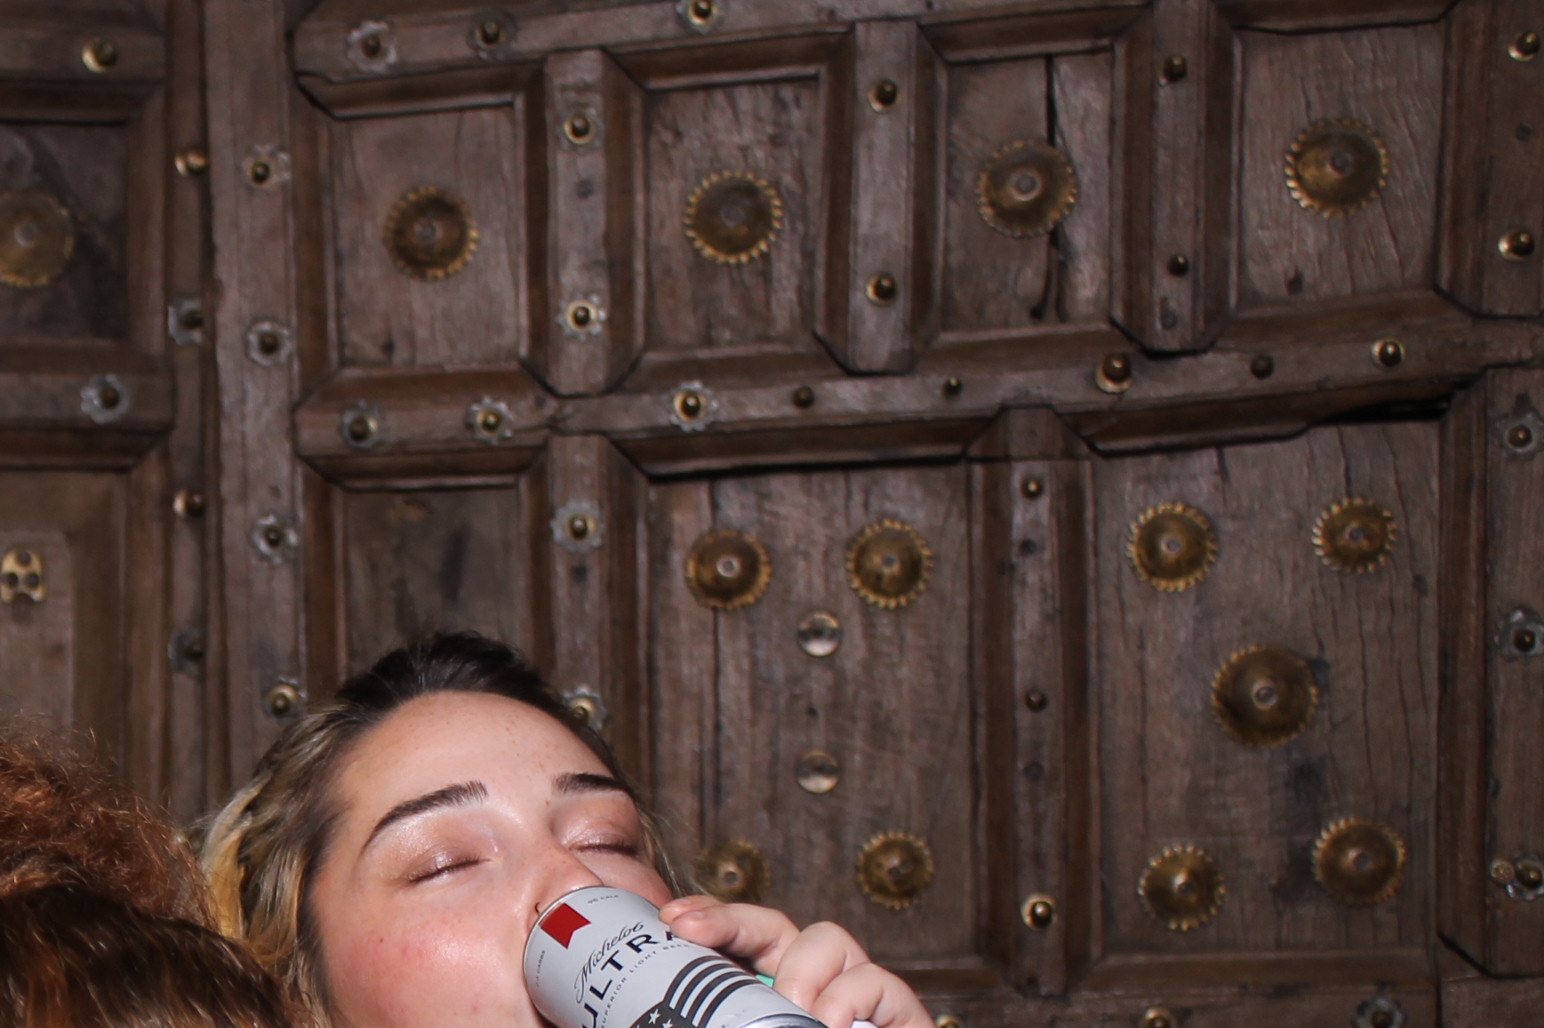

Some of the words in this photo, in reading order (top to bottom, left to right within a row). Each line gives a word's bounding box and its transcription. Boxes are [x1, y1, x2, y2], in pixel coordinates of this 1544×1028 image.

[574, 921, 644, 1004] Michelob
[601, 977, 627, 1028] SUPERIOR
[629, 950, 657, 973] LIGHT
